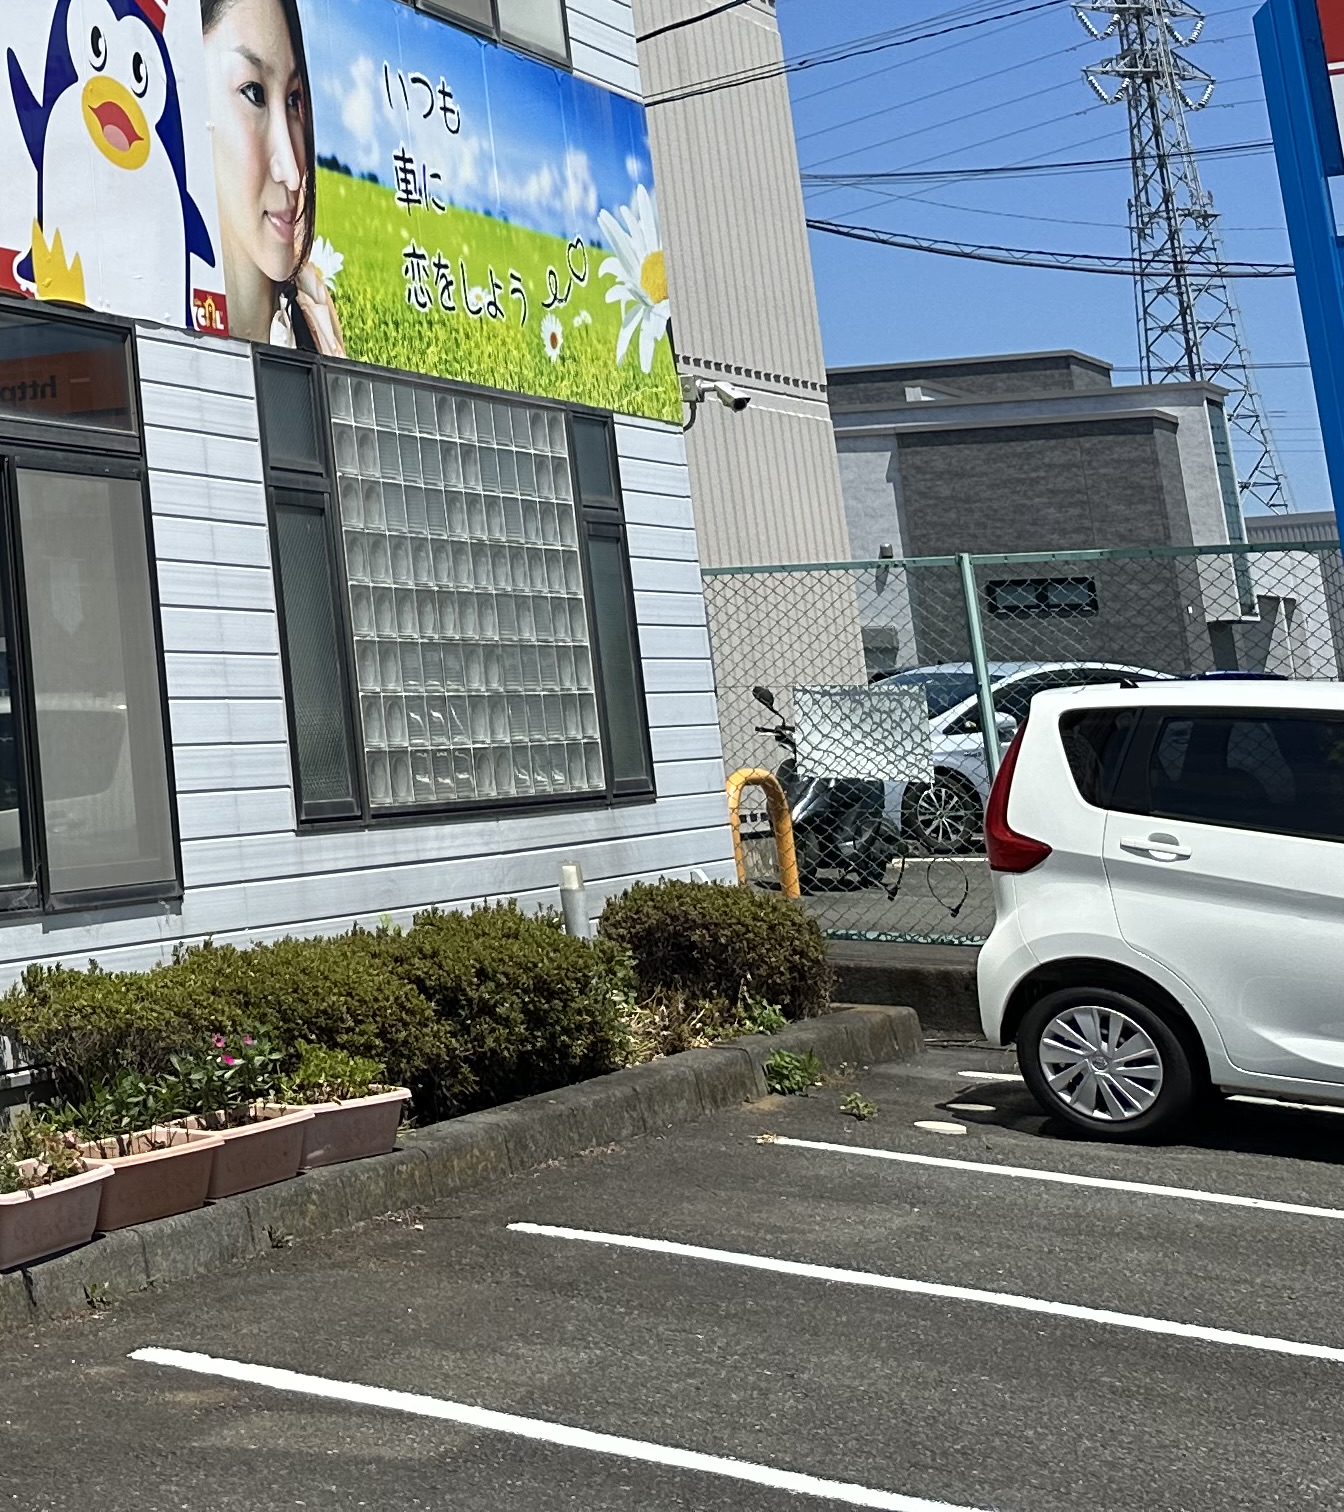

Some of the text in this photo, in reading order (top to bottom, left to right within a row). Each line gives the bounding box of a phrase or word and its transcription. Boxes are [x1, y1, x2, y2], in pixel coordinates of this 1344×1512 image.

[384, 60, 461, 135] いつも
[393, 146, 444, 215] 車に
[402, 240, 528, 326] 恋をしよう
